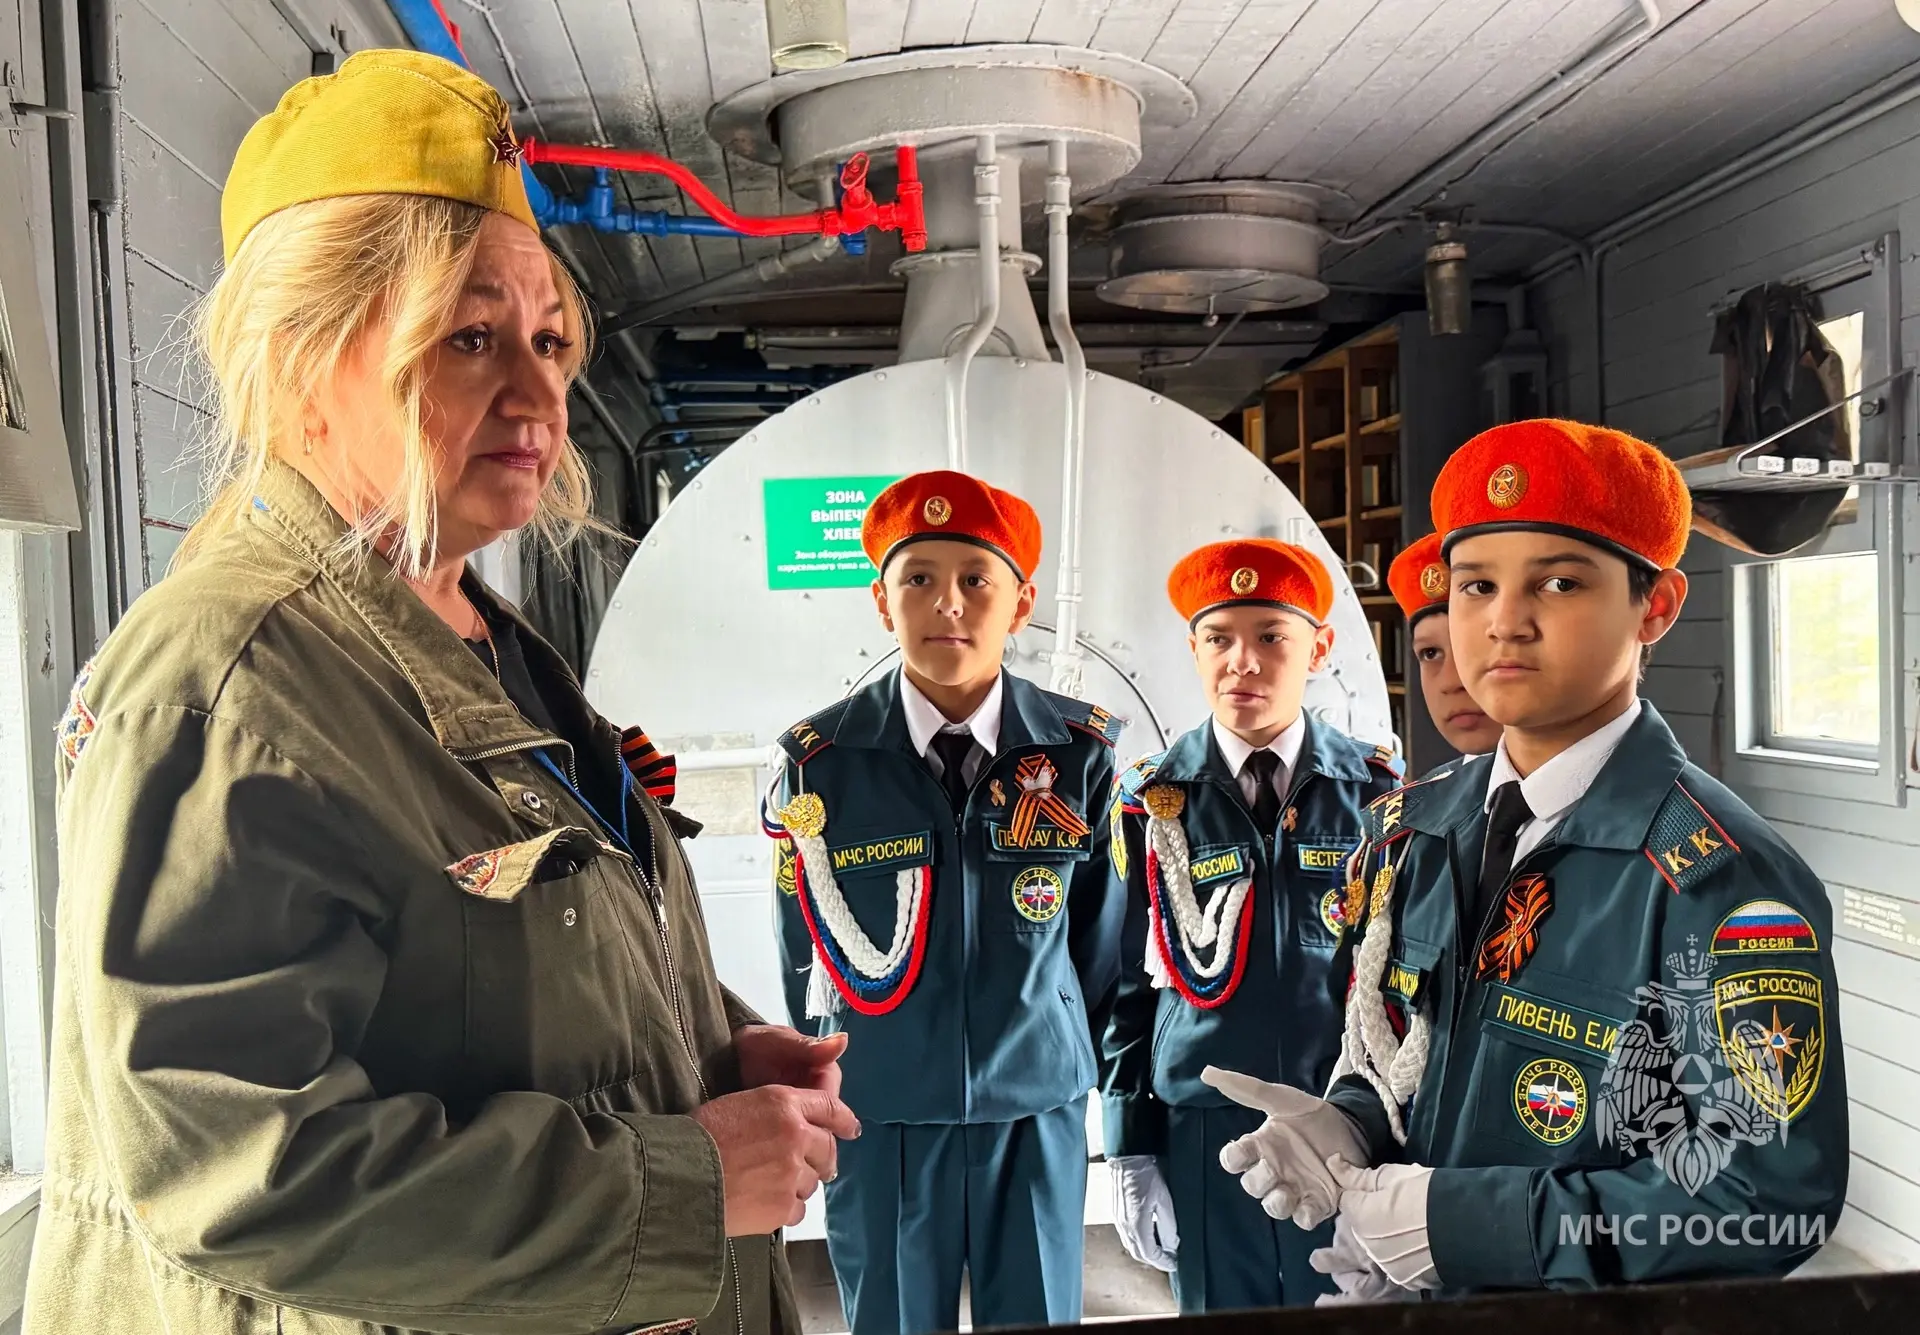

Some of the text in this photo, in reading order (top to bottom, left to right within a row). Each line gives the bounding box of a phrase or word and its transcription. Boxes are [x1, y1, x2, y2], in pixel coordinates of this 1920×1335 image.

[825, 490, 866, 503] ЗОНА
[833, 836, 924, 868] МЧС РОССИИ
[1738, 937, 1794, 950] РОССИЯ
[1722, 977, 1817, 1001] МЧС РОССИИ
[1496, 994, 1577, 1040] ПИВЕНЬ
[1520, 1064, 1543, 1086] МЧС
